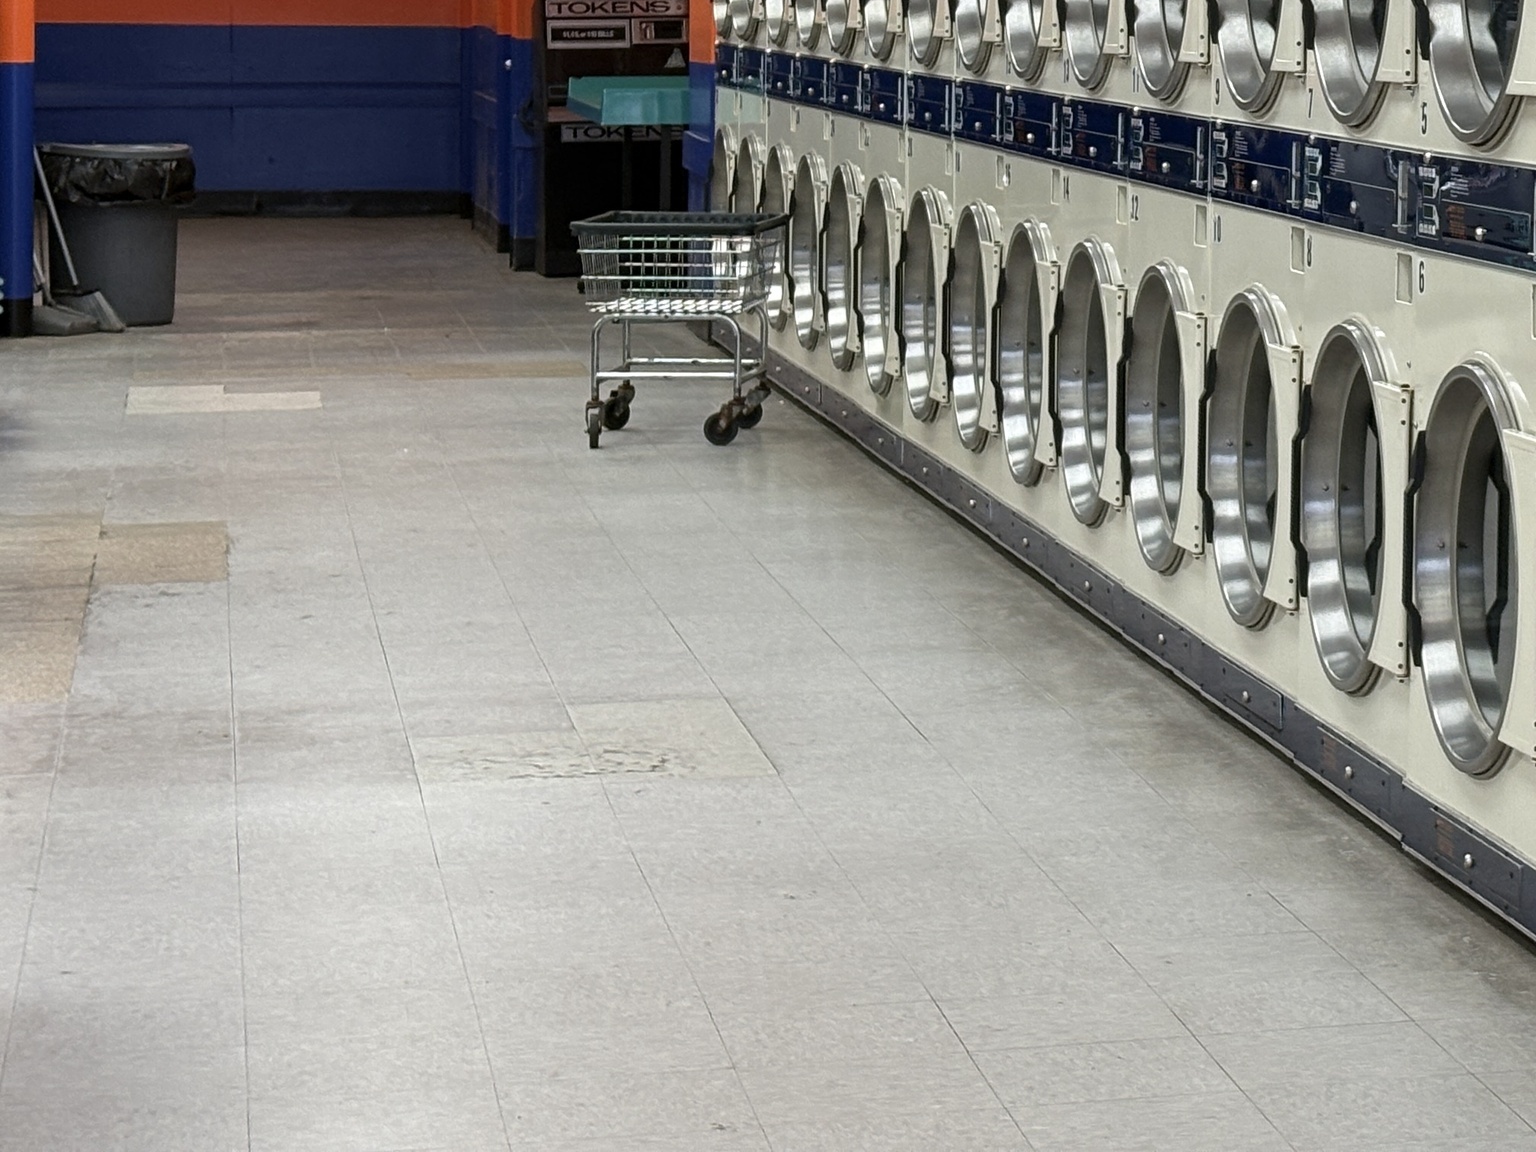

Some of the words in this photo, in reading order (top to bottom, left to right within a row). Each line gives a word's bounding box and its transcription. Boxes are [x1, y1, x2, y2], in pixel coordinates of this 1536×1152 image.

[549, 0, 670, 15] TOKENS
[1420, 102, 1428, 134] 5
[1306, 235, 1313, 268] 8
[1418, 261, 1426, 293] 6
